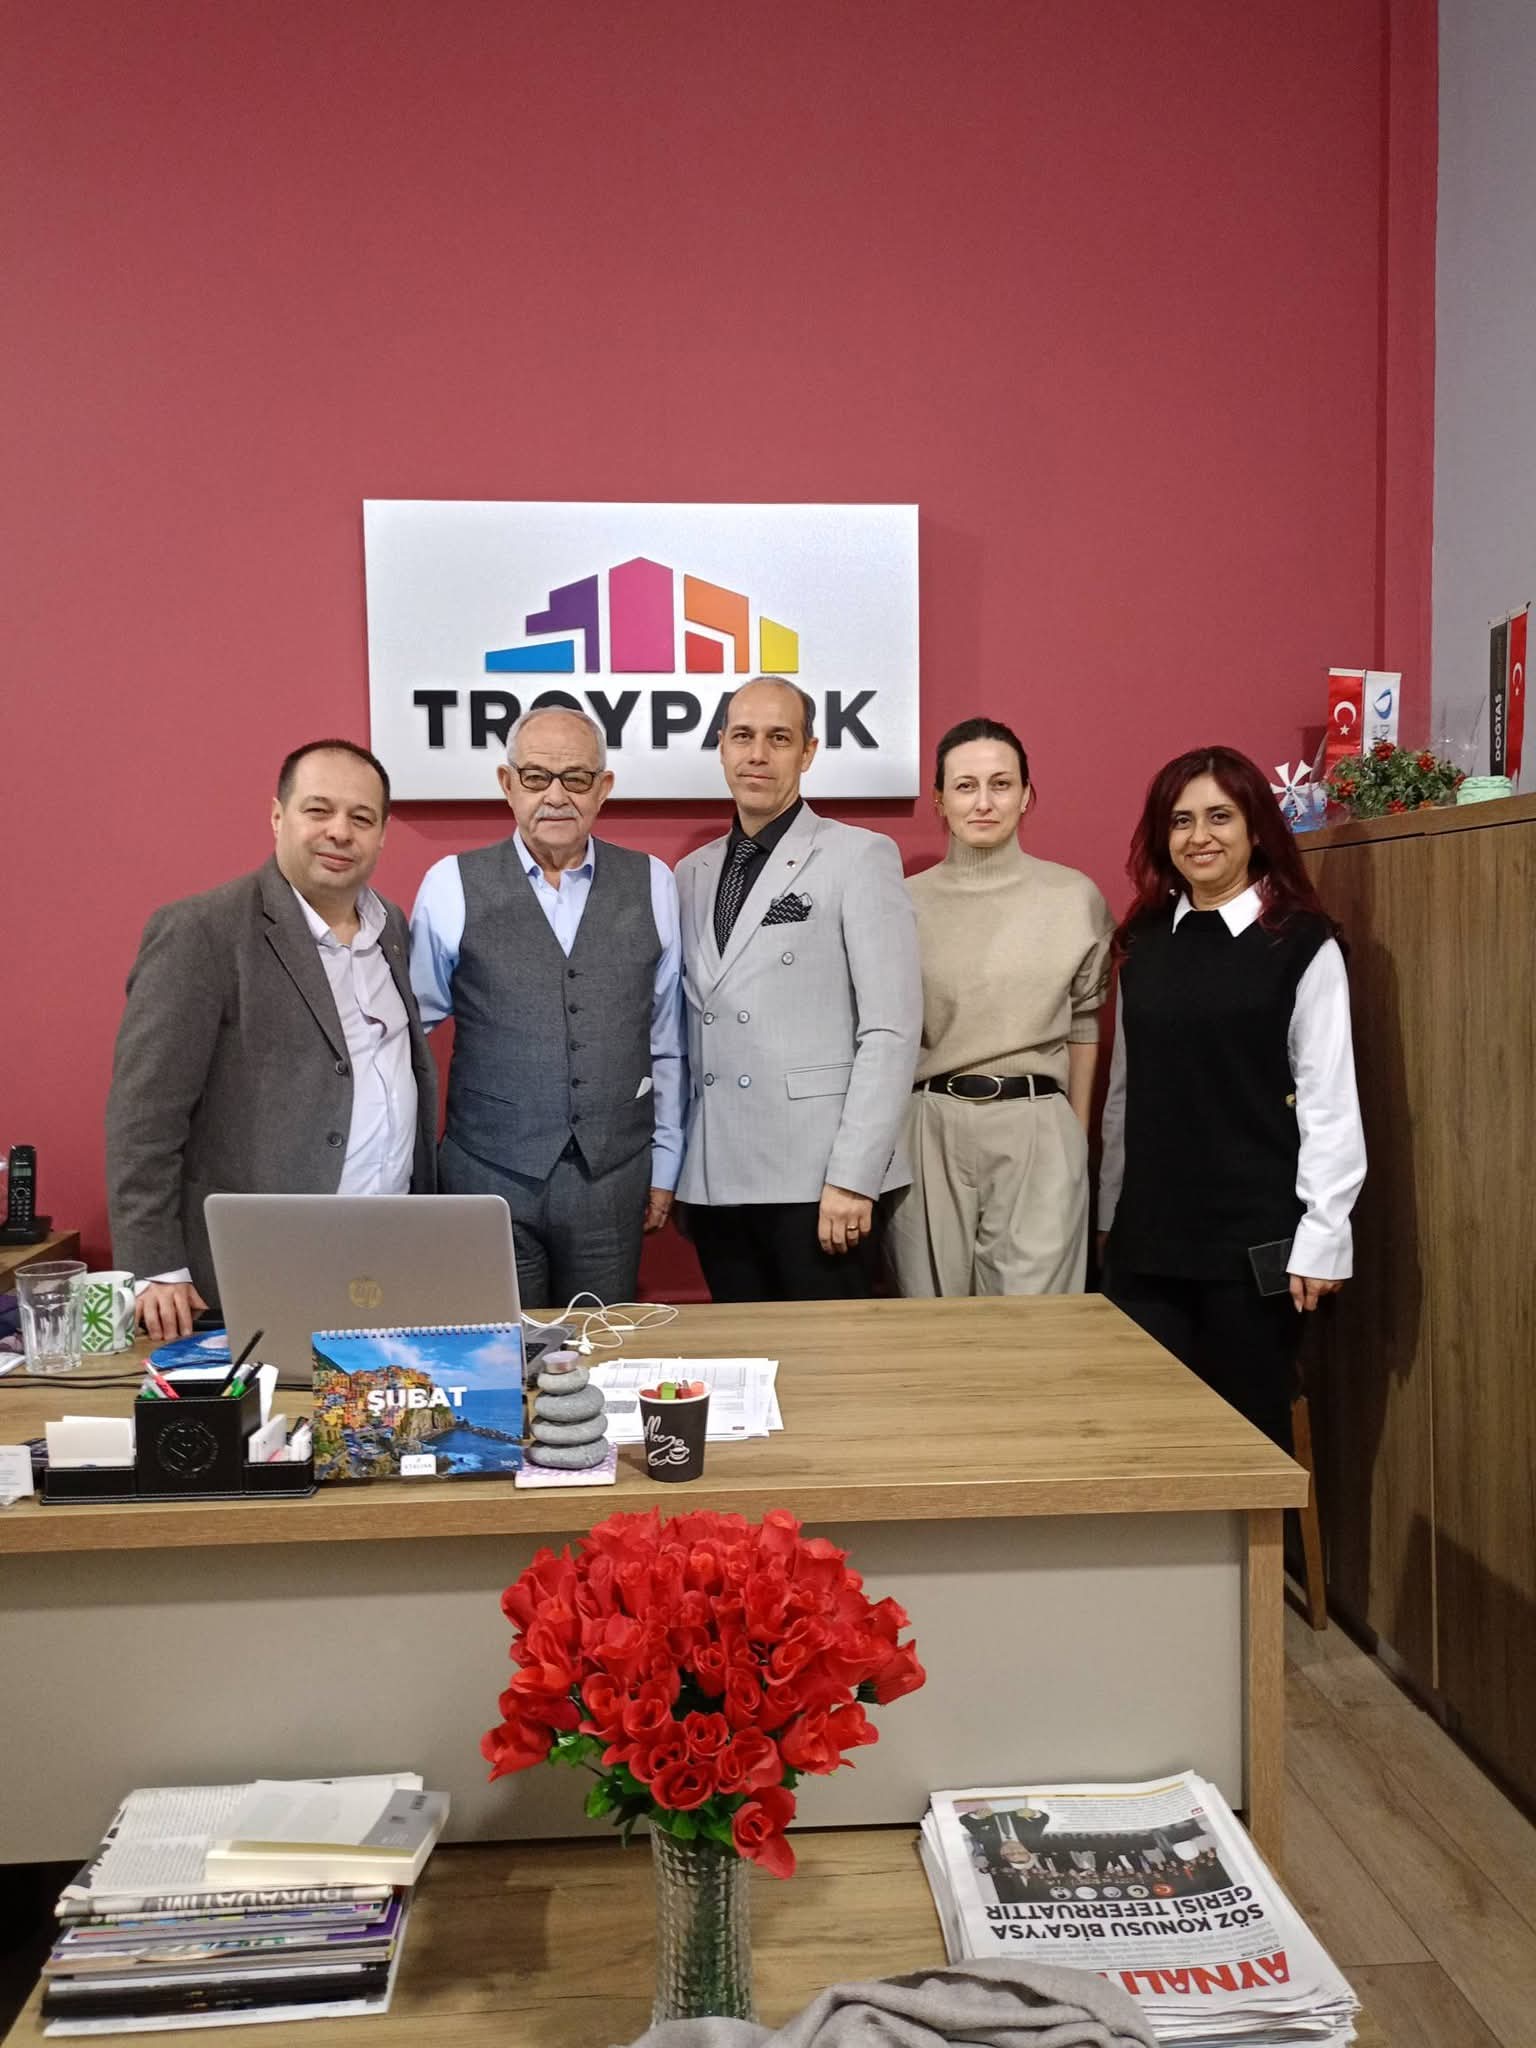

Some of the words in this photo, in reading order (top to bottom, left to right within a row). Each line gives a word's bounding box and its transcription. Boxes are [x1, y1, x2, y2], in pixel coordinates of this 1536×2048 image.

[413, 690, 880, 750] TRYPK
[366, 1386, 468, 1417] ŞUBAT
[984, 1902, 1171, 1920] TEFERRUATTIR
[1173, 1886, 1253, 1918] GERİSİ
[1214, 1903, 1264, 1929] SÖZ
[990, 1922, 1106, 1941] BİGA'YSA
[1111, 1917, 1212, 1937] KONUSU
[1119, 1951, 1290, 1995] AYNALI
